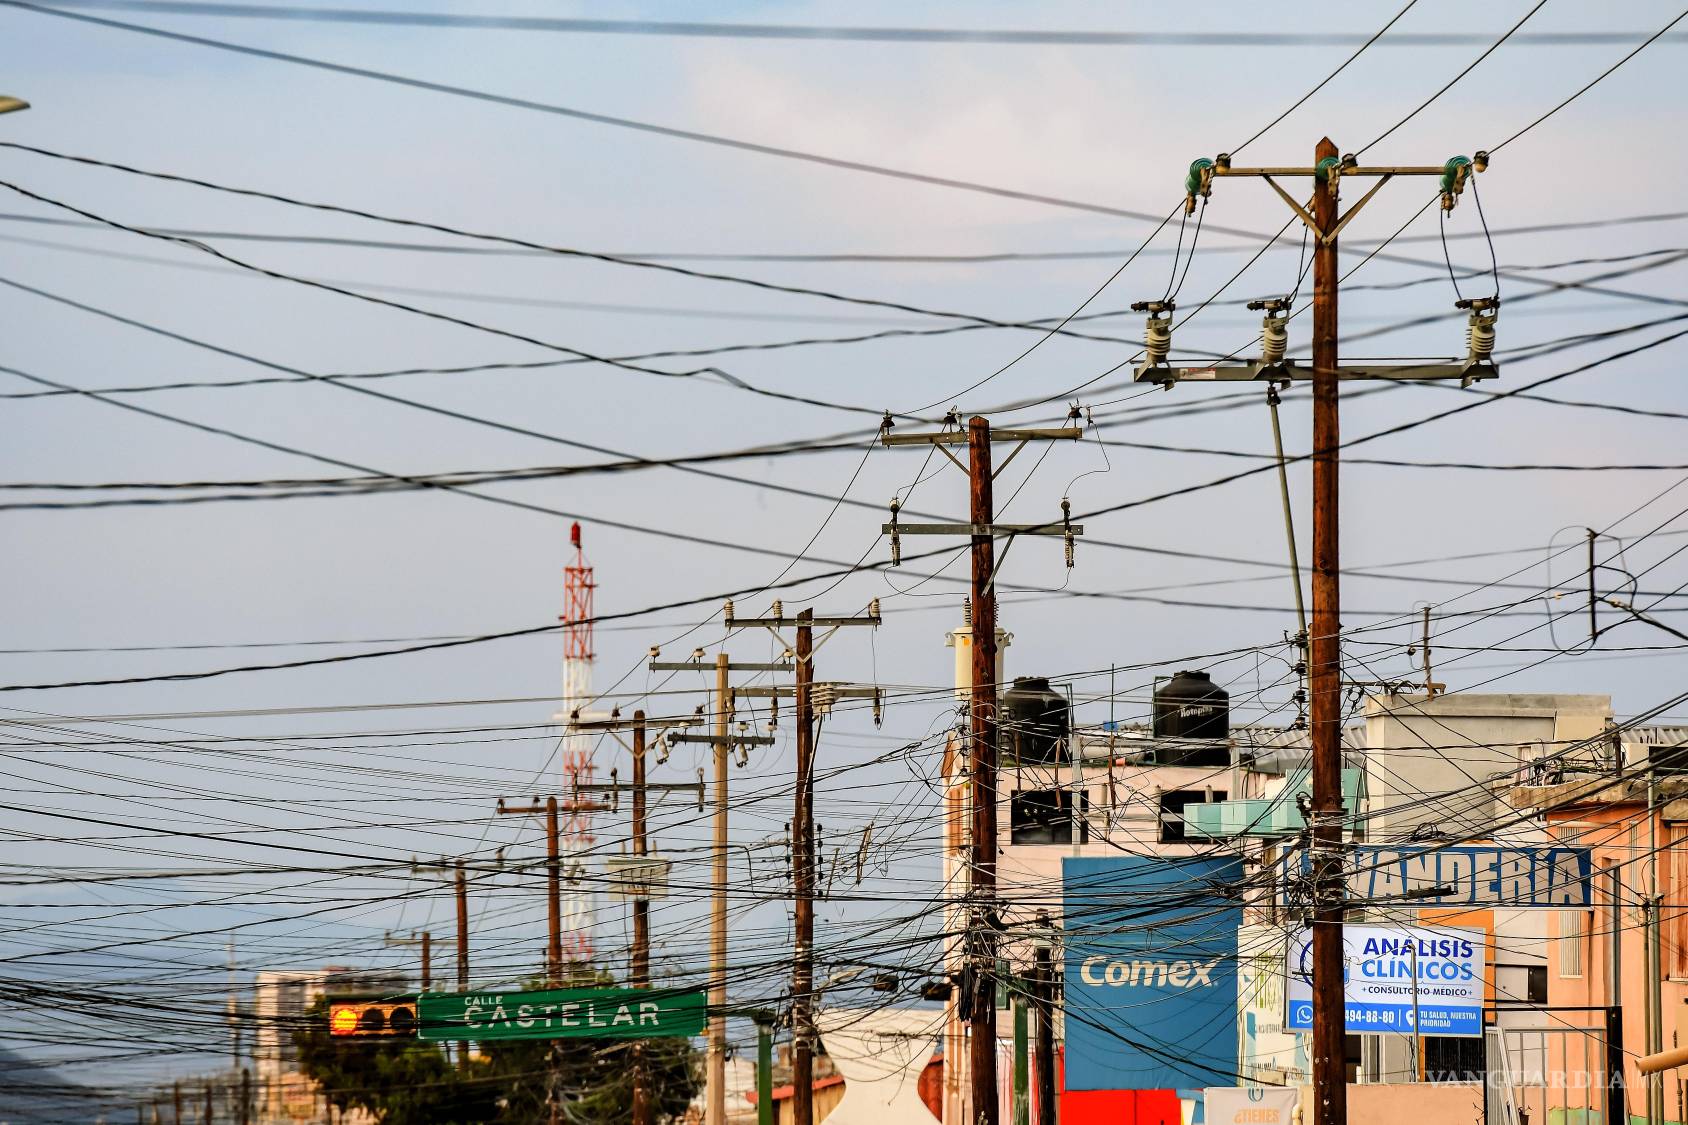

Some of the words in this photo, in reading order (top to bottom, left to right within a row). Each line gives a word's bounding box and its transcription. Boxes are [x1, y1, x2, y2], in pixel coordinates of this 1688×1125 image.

[1363, 936, 1473, 958] ANÁLISIS
[1080, 956, 1218, 988] Comex
[1361, 957, 1473, 980] CLÍNICOS
[464, 996, 503, 1006] CALLE
[1433, 986, 1467, 996] MÉDICO
[463, 1002, 660, 1028] CASTELAR
[1420, 1010, 1428, 1019] TU
